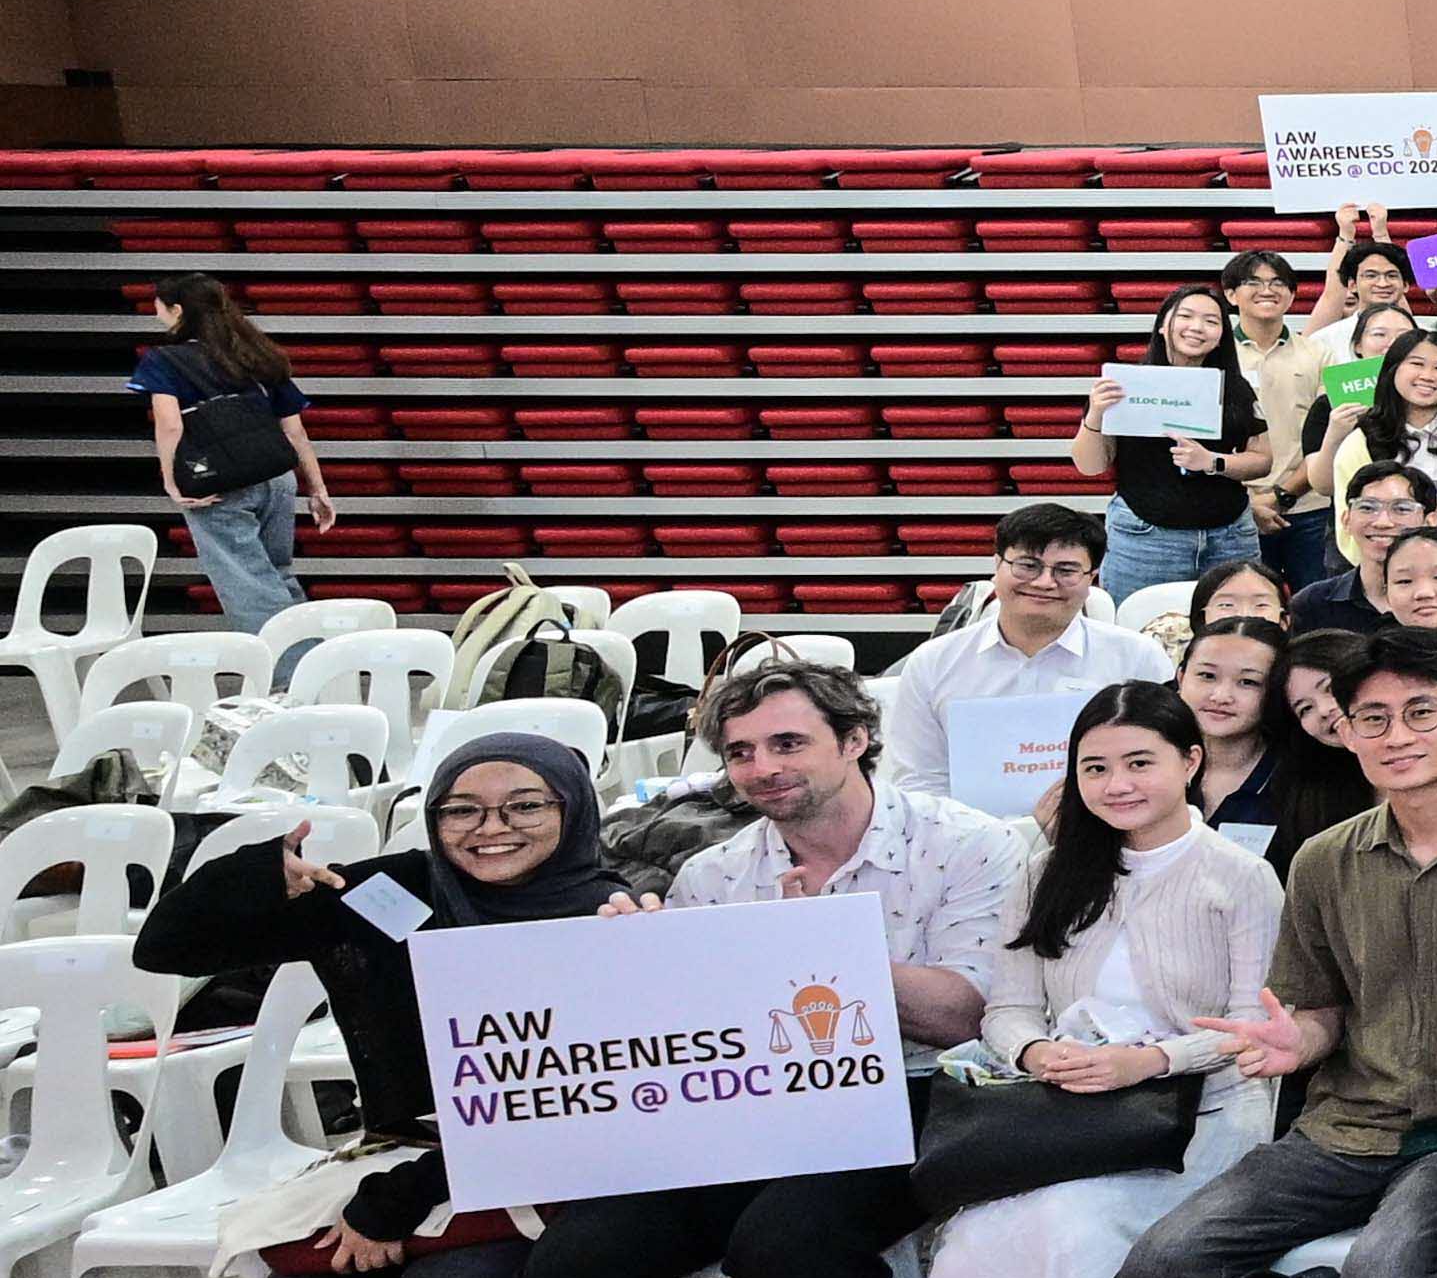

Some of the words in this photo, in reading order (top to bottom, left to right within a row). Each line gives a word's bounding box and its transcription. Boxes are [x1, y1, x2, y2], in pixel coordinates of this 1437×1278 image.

[1275, 131, 1316, 145] LAW
[1276, 145, 1394, 161] AWARENESS
[1276, 162, 1342, 178] WEEKS
[1347, 164, 1363, 178] @
[1367, 161, 1404, 175] CDC
[1019, 741, 1068, 754] Mood
[1003, 760, 1065, 773] Repair
[448, 1008, 552, 1048] LAW
[454, 1028, 747, 1087] AWARENESS
[453, 1081, 618, 1126] WEEKS
[631, 1082, 668, 1113] @
[681, 1065, 772, 1103] CDC
[784, 1054, 885, 1094] 2026
